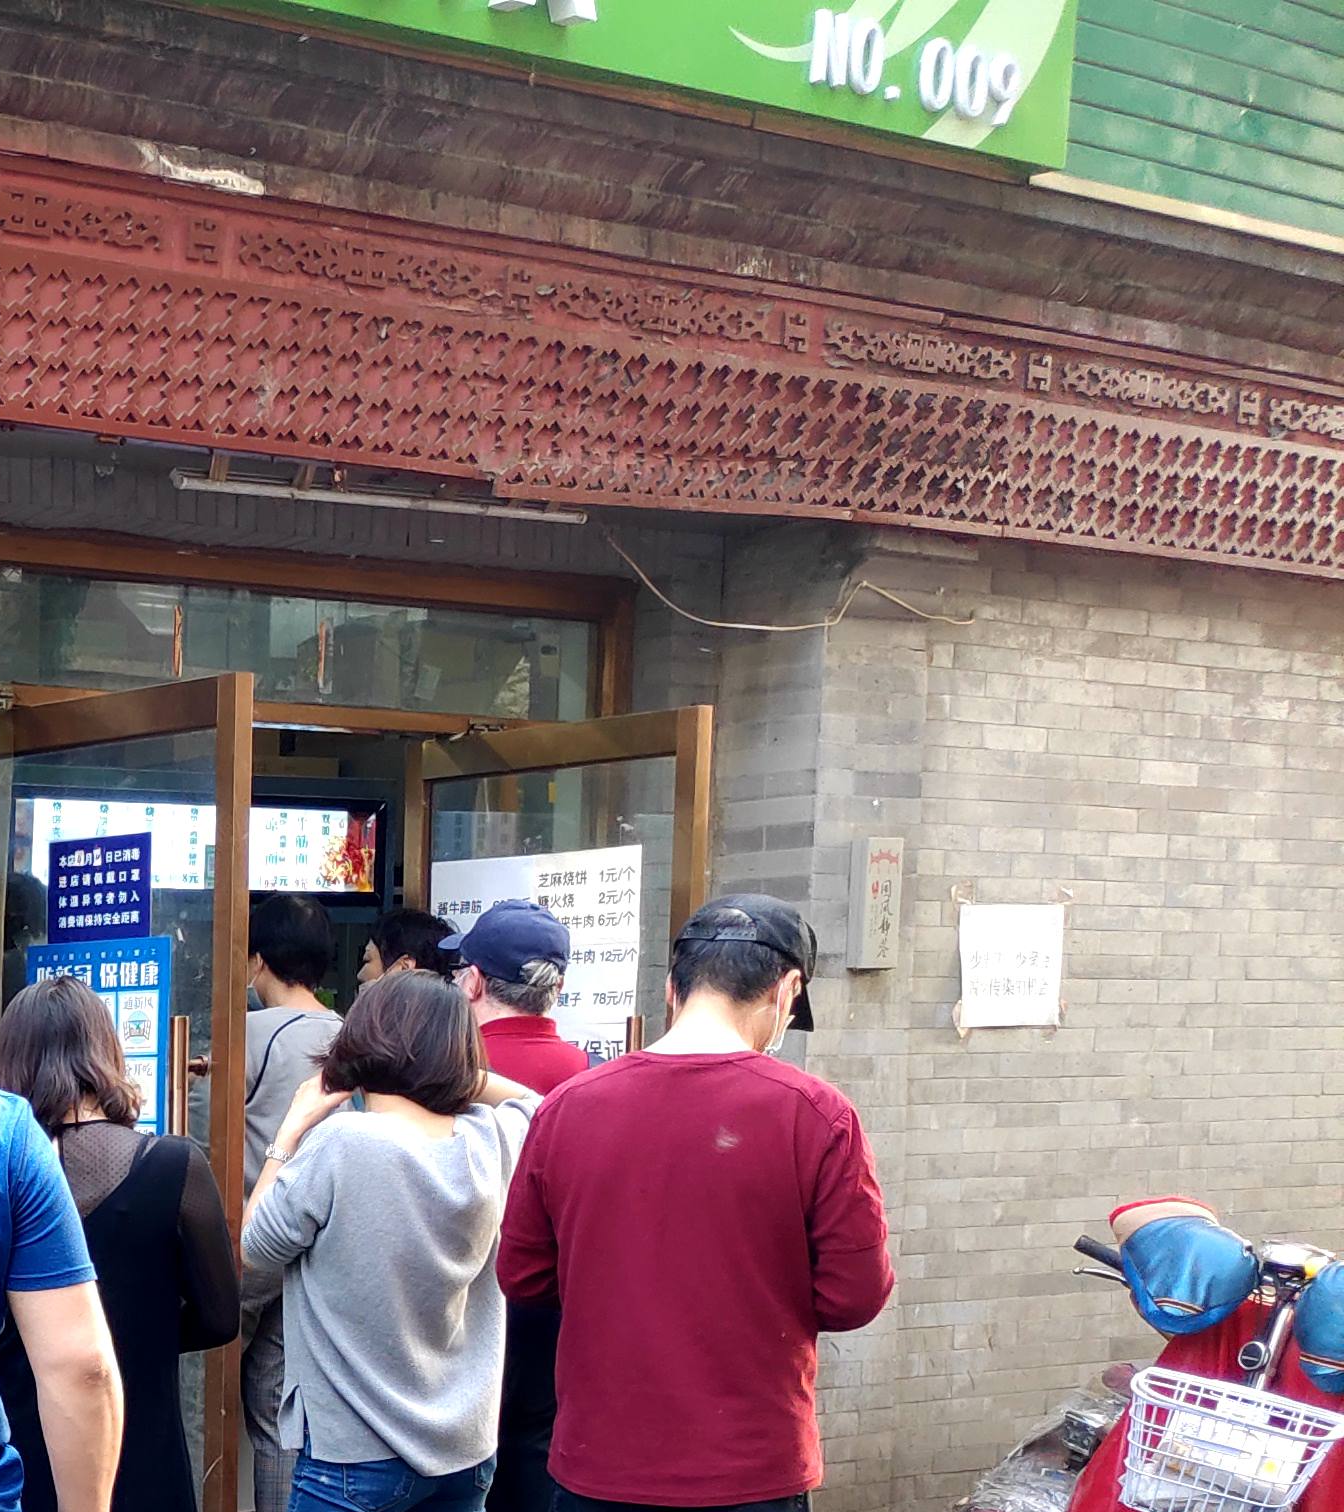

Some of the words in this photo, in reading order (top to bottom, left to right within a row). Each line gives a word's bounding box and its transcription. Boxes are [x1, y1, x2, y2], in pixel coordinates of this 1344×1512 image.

[809, 8, 900, 95] NO.
[919, 36, 1018, 127] 009
[538, 872, 587, 888] 芝麻烧饼
[599, 866, 636, 884] 1元/个
[58, 890, 141, 909] 体温异常者勿入
[598, 888, 636, 905] 2元/个
[555, 913, 595, 929] 夹牛肉
[597, 910, 636, 927] 6元/个
[568, 949, 596, 965] 牛肉
[599, 947, 638, 963] 12元/个
[100, 960, 159, 988] 保健康
[592, 989, 634, 1006] 78元/斤
